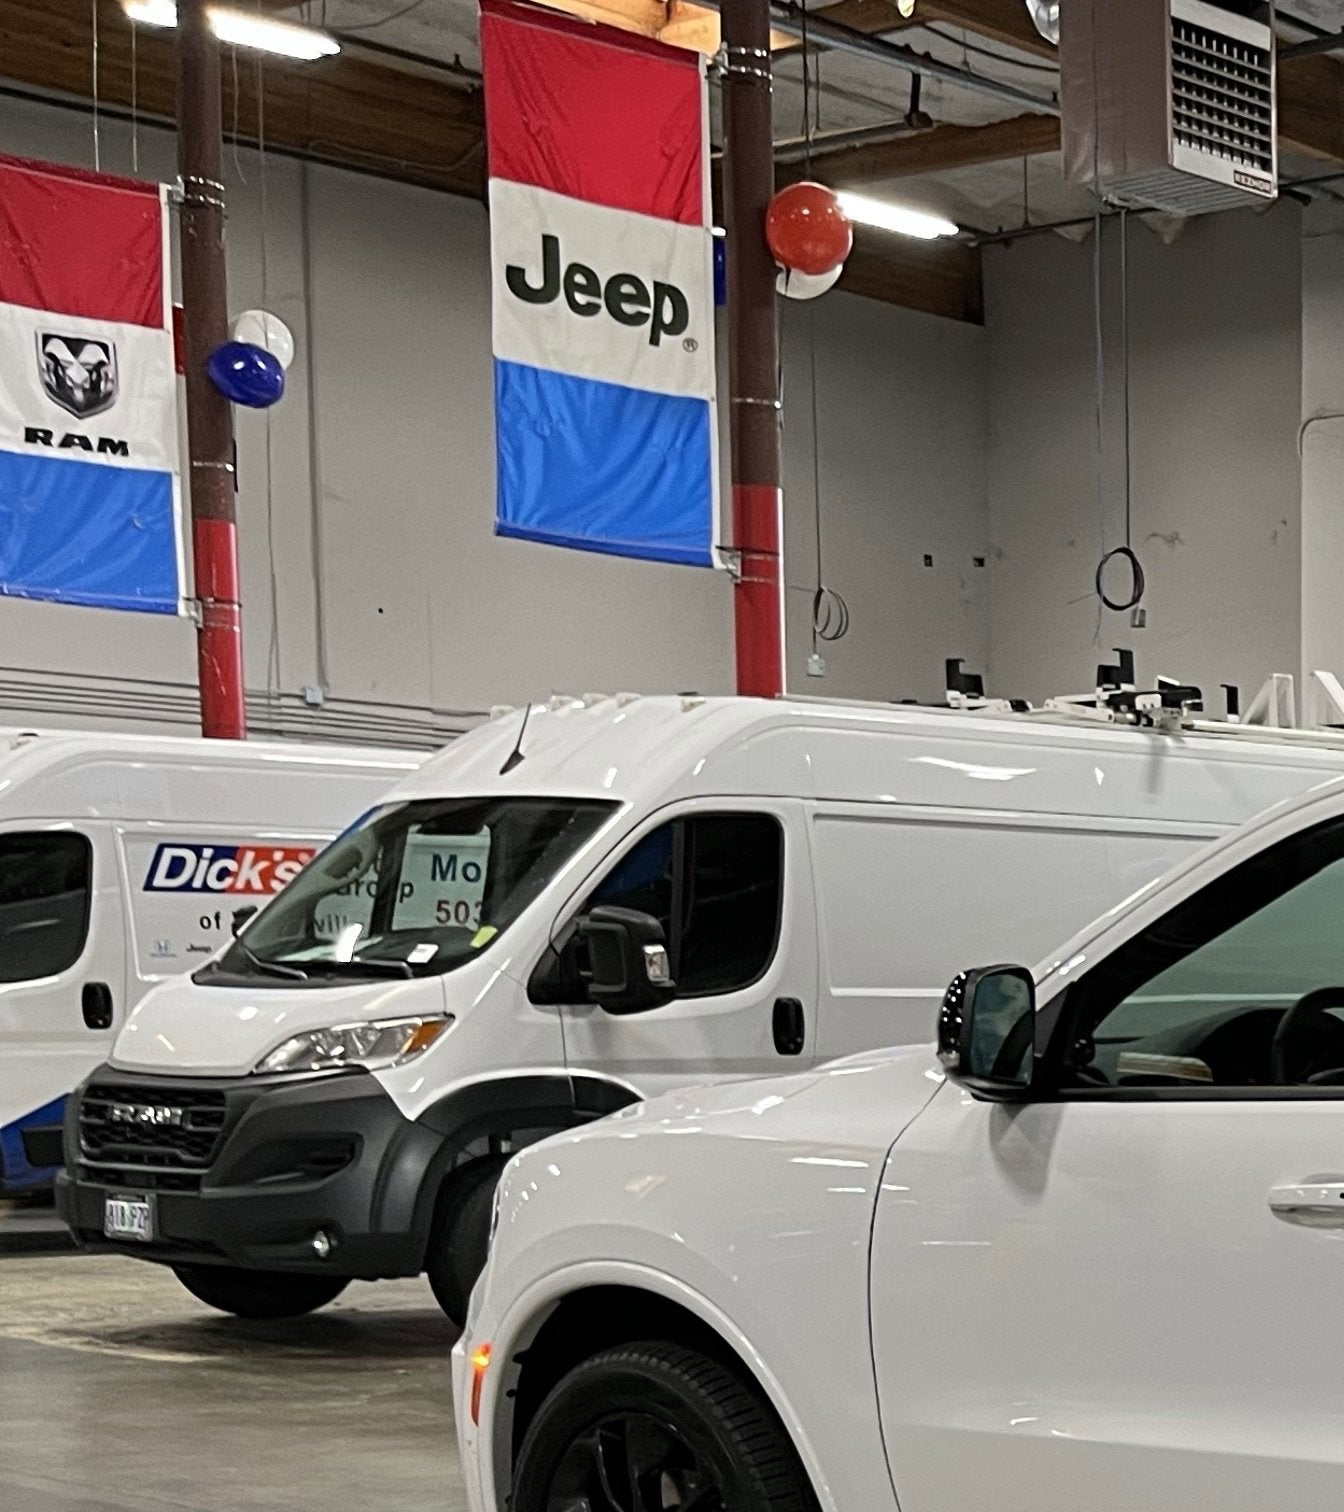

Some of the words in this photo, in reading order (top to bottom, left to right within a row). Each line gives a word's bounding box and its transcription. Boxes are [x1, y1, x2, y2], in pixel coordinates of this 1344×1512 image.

[505, 234, 690, 346] Jeep
[24, 426, 129, 458] RAM
[200, 911, 221, 930] of
